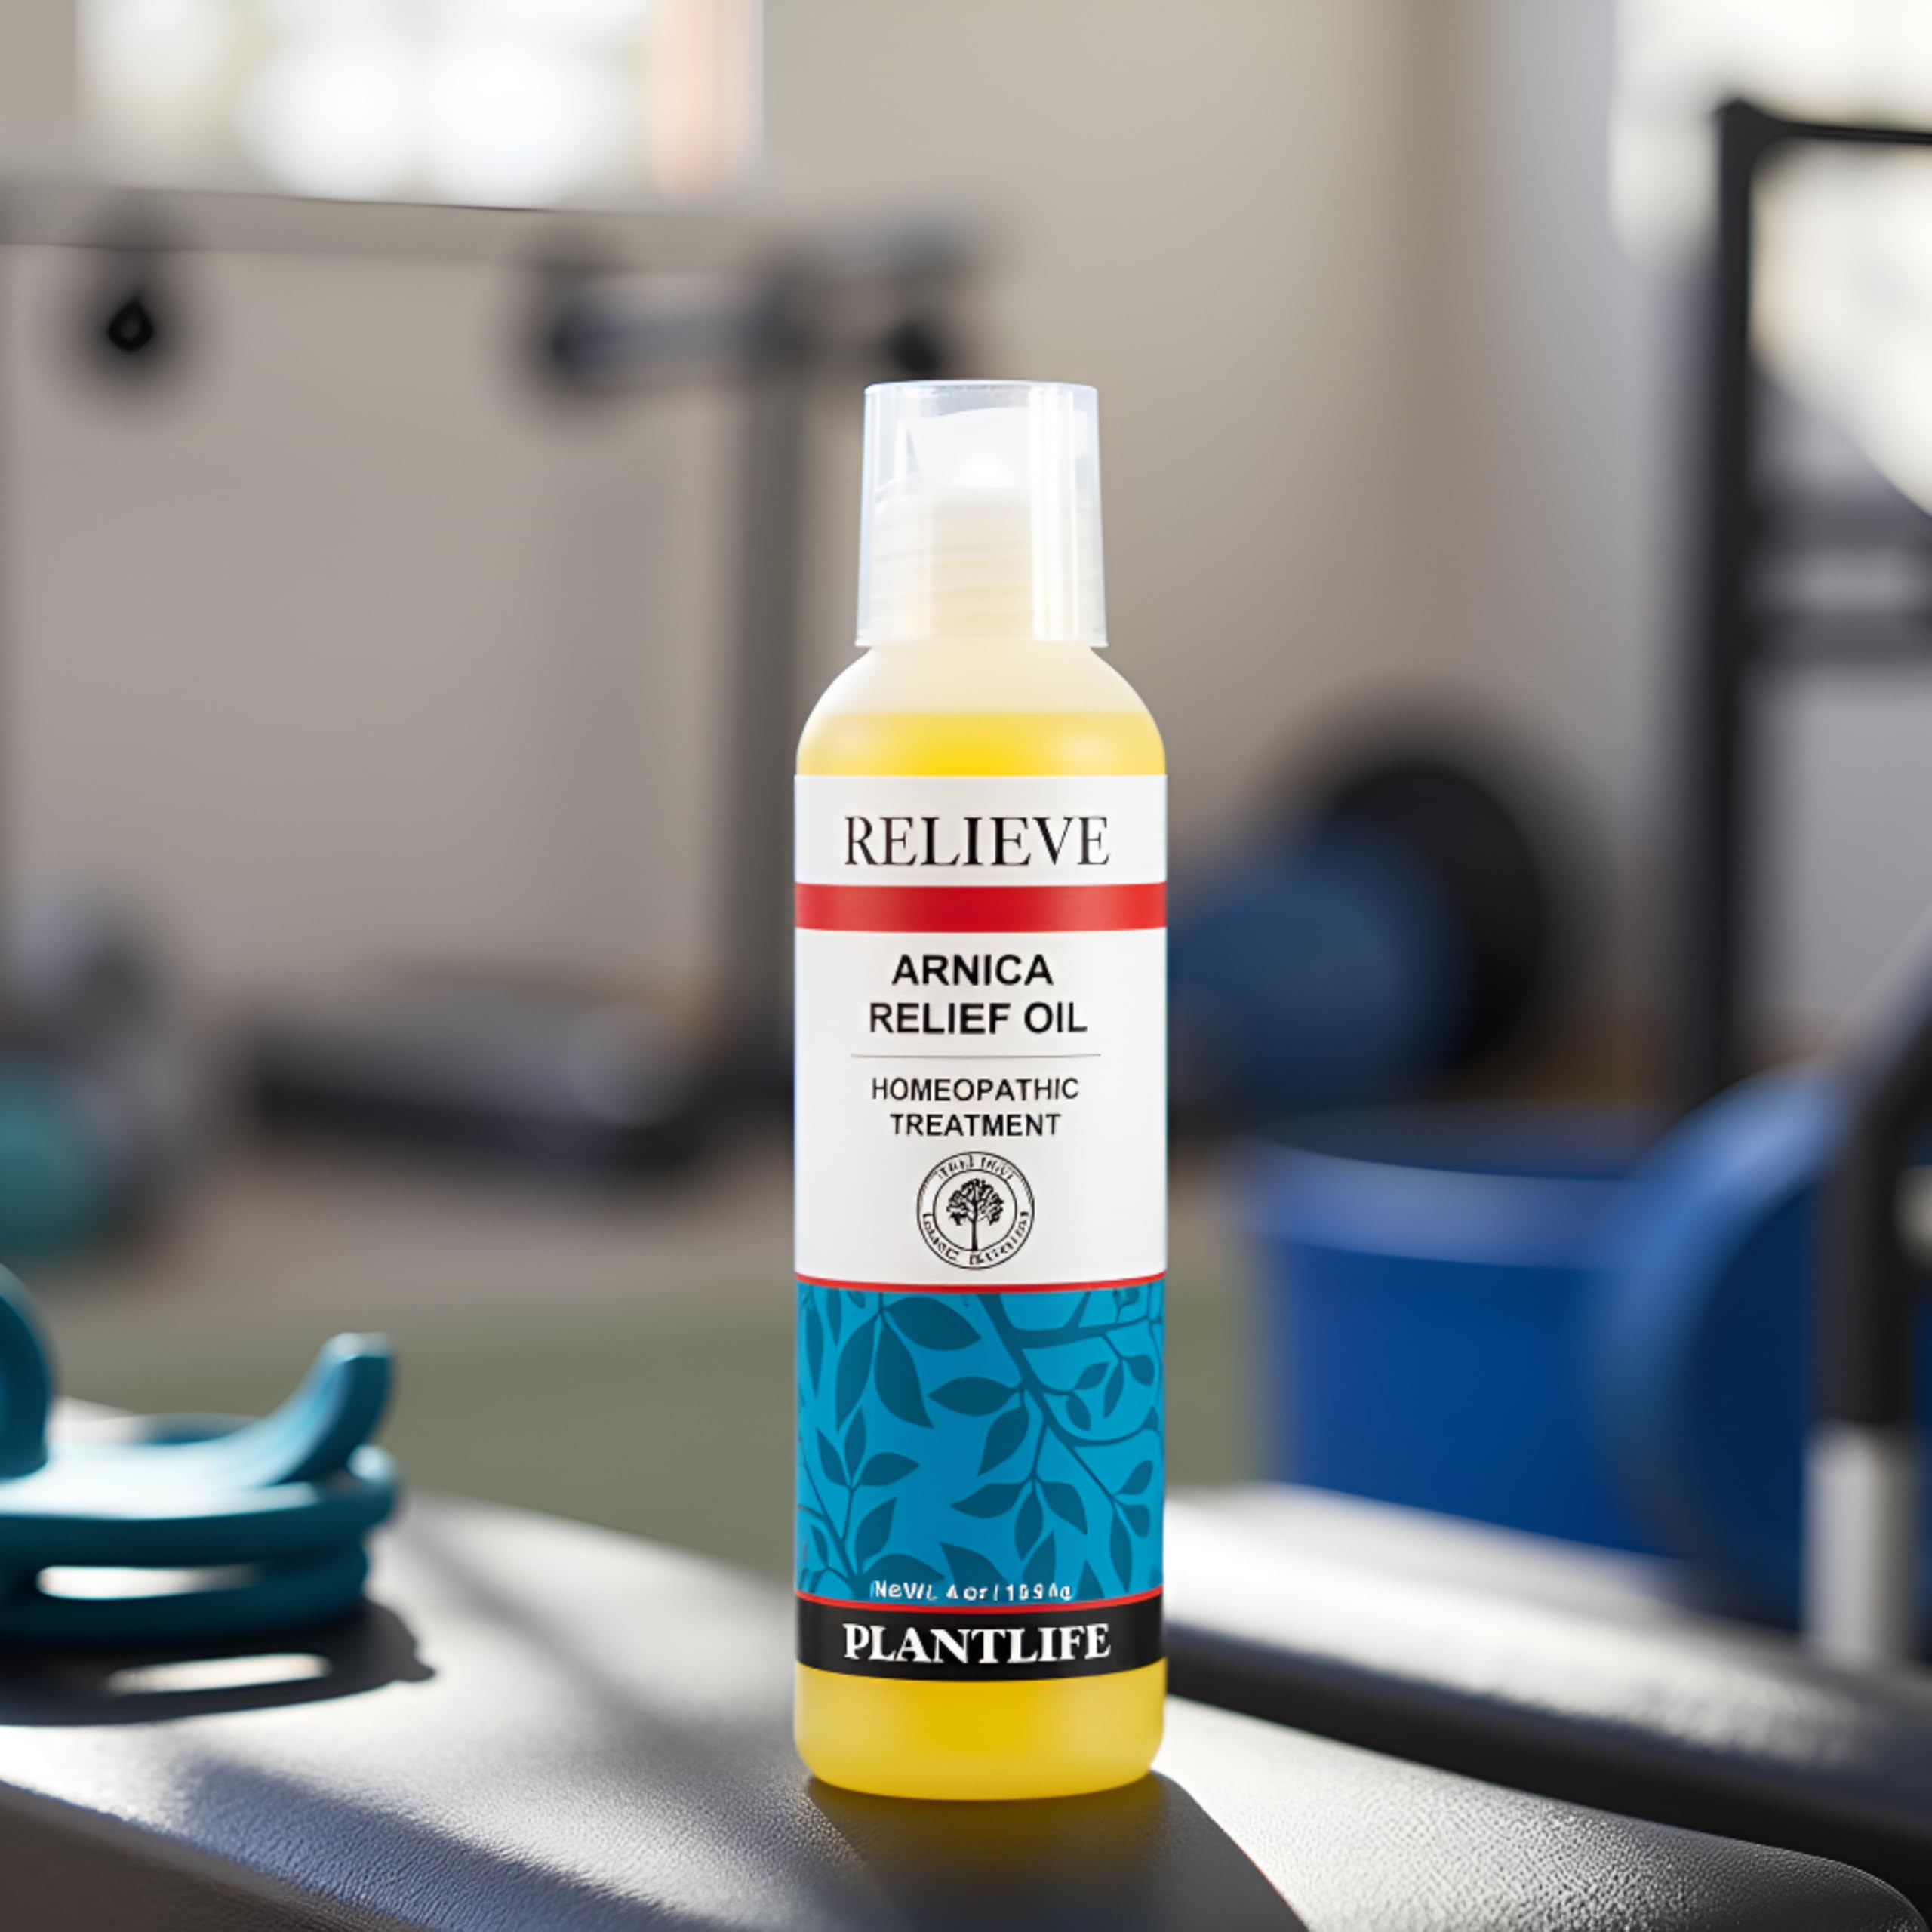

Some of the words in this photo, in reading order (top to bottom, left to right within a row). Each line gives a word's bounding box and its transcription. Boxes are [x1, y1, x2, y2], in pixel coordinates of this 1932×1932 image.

[844, 815, 1110, 866] RELIEVE
[891, 953, 1054, 986] ARNICA
[869, 1002, 1011, 1035] RELIEF
[1023, 1001, 1088, 1034] OIL
[872, 1077, 1079, 1102] HOMEOPATHIC
[889, 1113, 1061, 1137] TREATMENT
[842, 1623, 1112, 1664] PLANTLIFE
